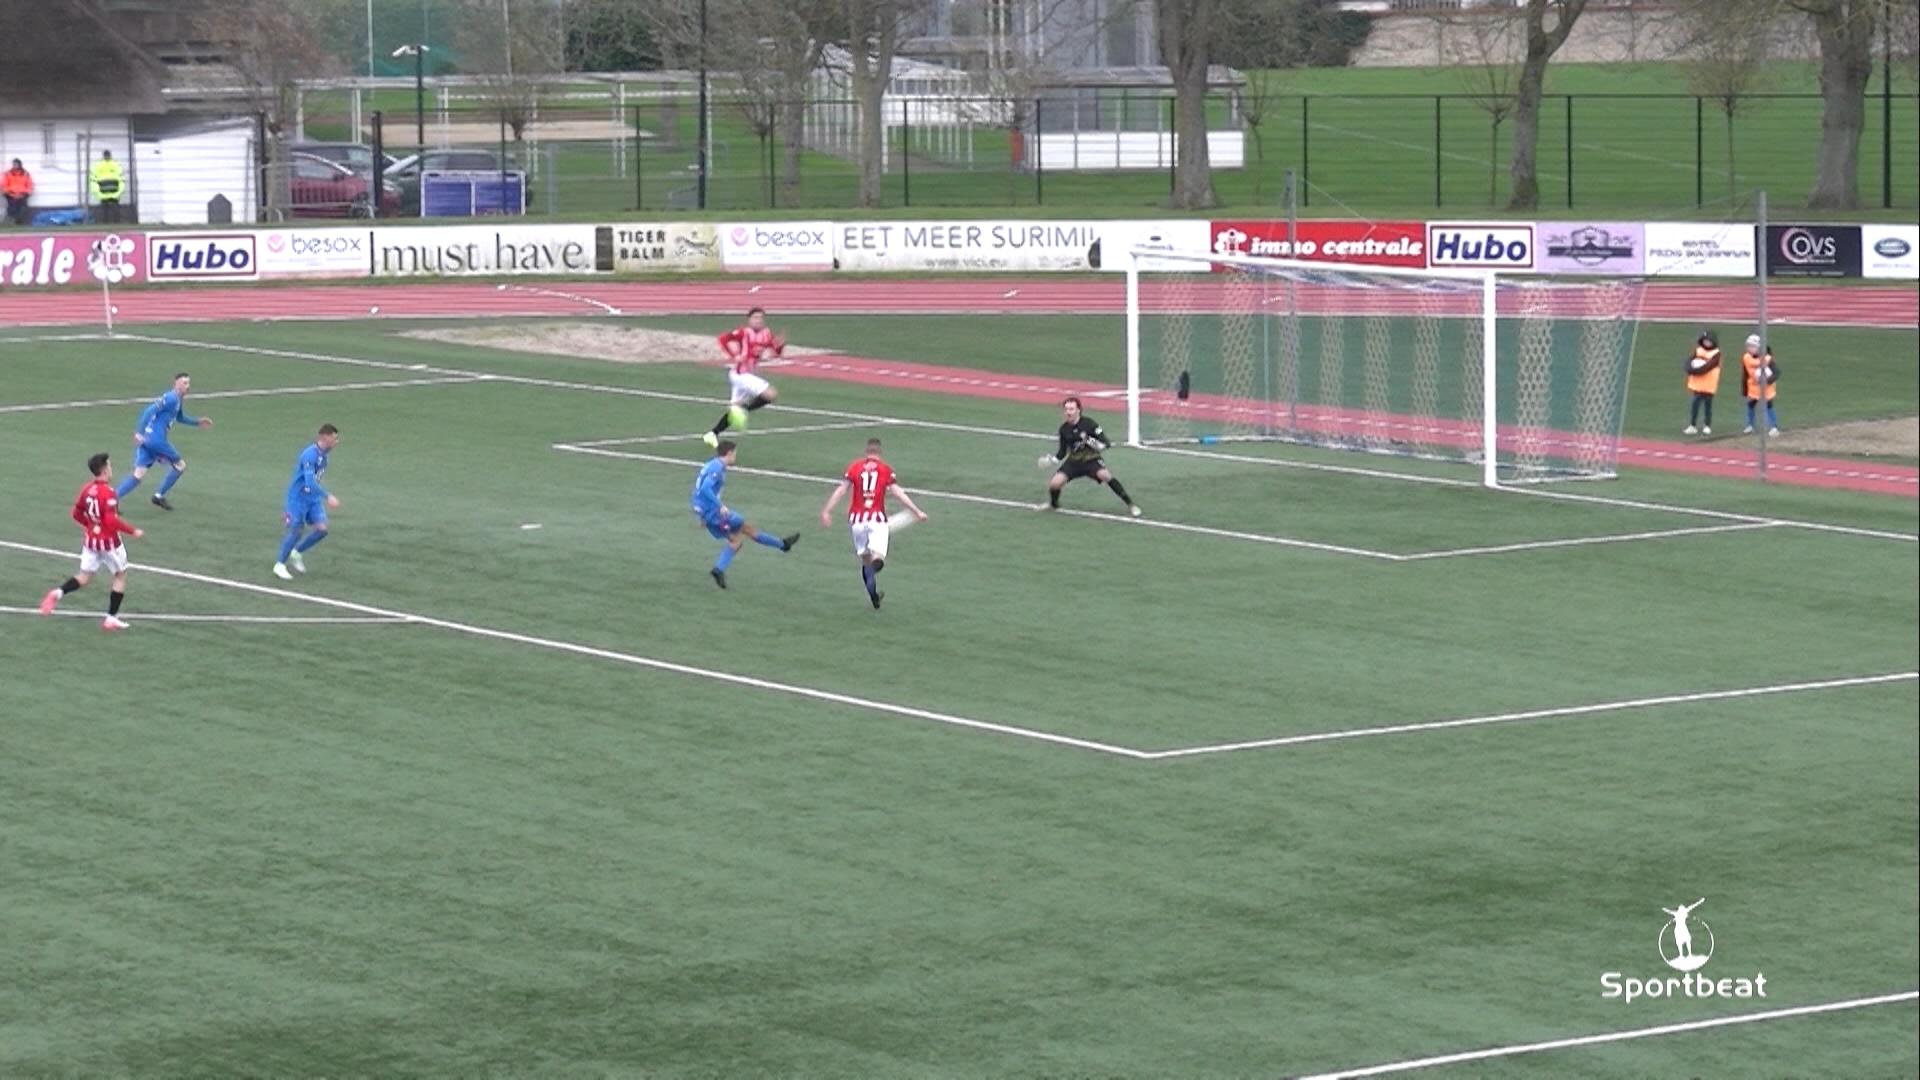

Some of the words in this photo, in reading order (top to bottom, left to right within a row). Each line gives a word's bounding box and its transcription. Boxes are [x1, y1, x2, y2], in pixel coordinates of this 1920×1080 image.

[291, 232, 362, 255] besox
[618, 230, 666, 243] TIGER
[755, 227, 825, 247] besox
[843, 226, 894, 249] EET
[904, 225, 983, 248] MEER
[1250, 236, 1317, 255] immo
[1322, 236, 1424, 256] centrale
[1436, 233, 1528, 261] Hubo
[156, 242, 250, 270] Hubo
[619, 247, 665, 260] BALM
[860, 471, 879, 491] 17
[84, 495, 102, 523] 21
